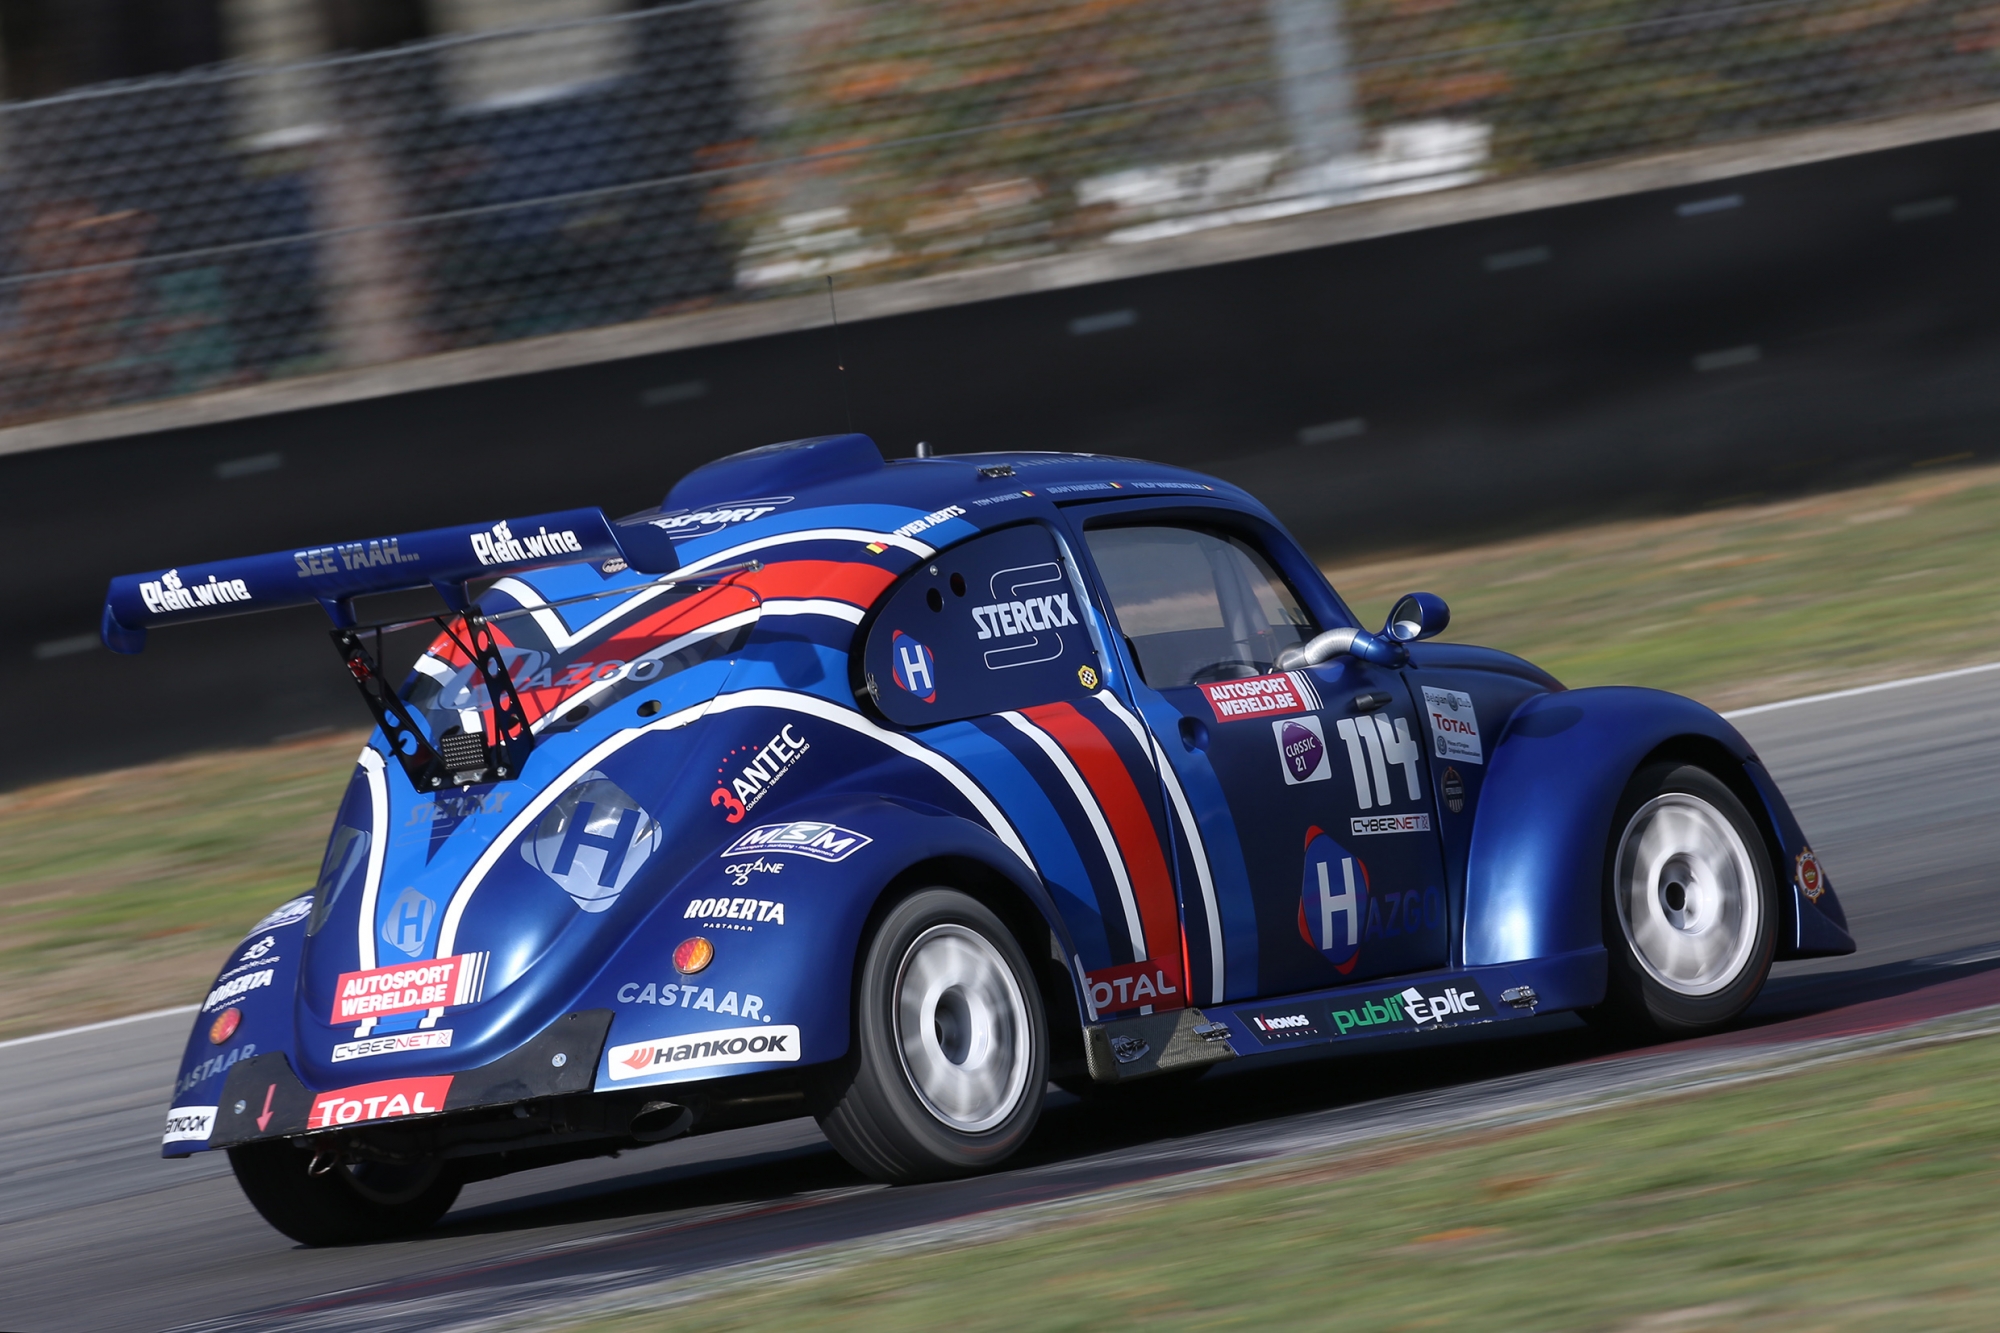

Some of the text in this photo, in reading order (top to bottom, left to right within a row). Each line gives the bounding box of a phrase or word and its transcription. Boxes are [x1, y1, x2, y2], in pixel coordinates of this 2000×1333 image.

[924, 505, 966, 526] AERTS
[294, 548, 338, 578] SEE
[972, 593, 1078, 640] STERCKX
[900, 645, 932, 691] H
[1210, 678, 1289, 701] AUTOSPORT
[1217, 692, 1297, 716] WERELD.BE
[1432, 713, 1476, 736] TOTAL
[1285, 736, 1316, 758] CLASSIC
[1295, 755, 1307, 772] 21
[1336, 712, 1421, 809] 114
[725, 857, 784, 875] OCTANE
[683, 898, 784, 925] ROBERTA
[703, 923, 753, 932] PASTABAR
[342, 964, 454, 998] AUTOSPORT
[1086, 970, 1176, 1009] OTAL
[341, 984, 447, 1016] WERELD.BE
[1253, 1013, 1310, 1031] KRONOS
[318, 1092, 436, 1127] TOTAL
